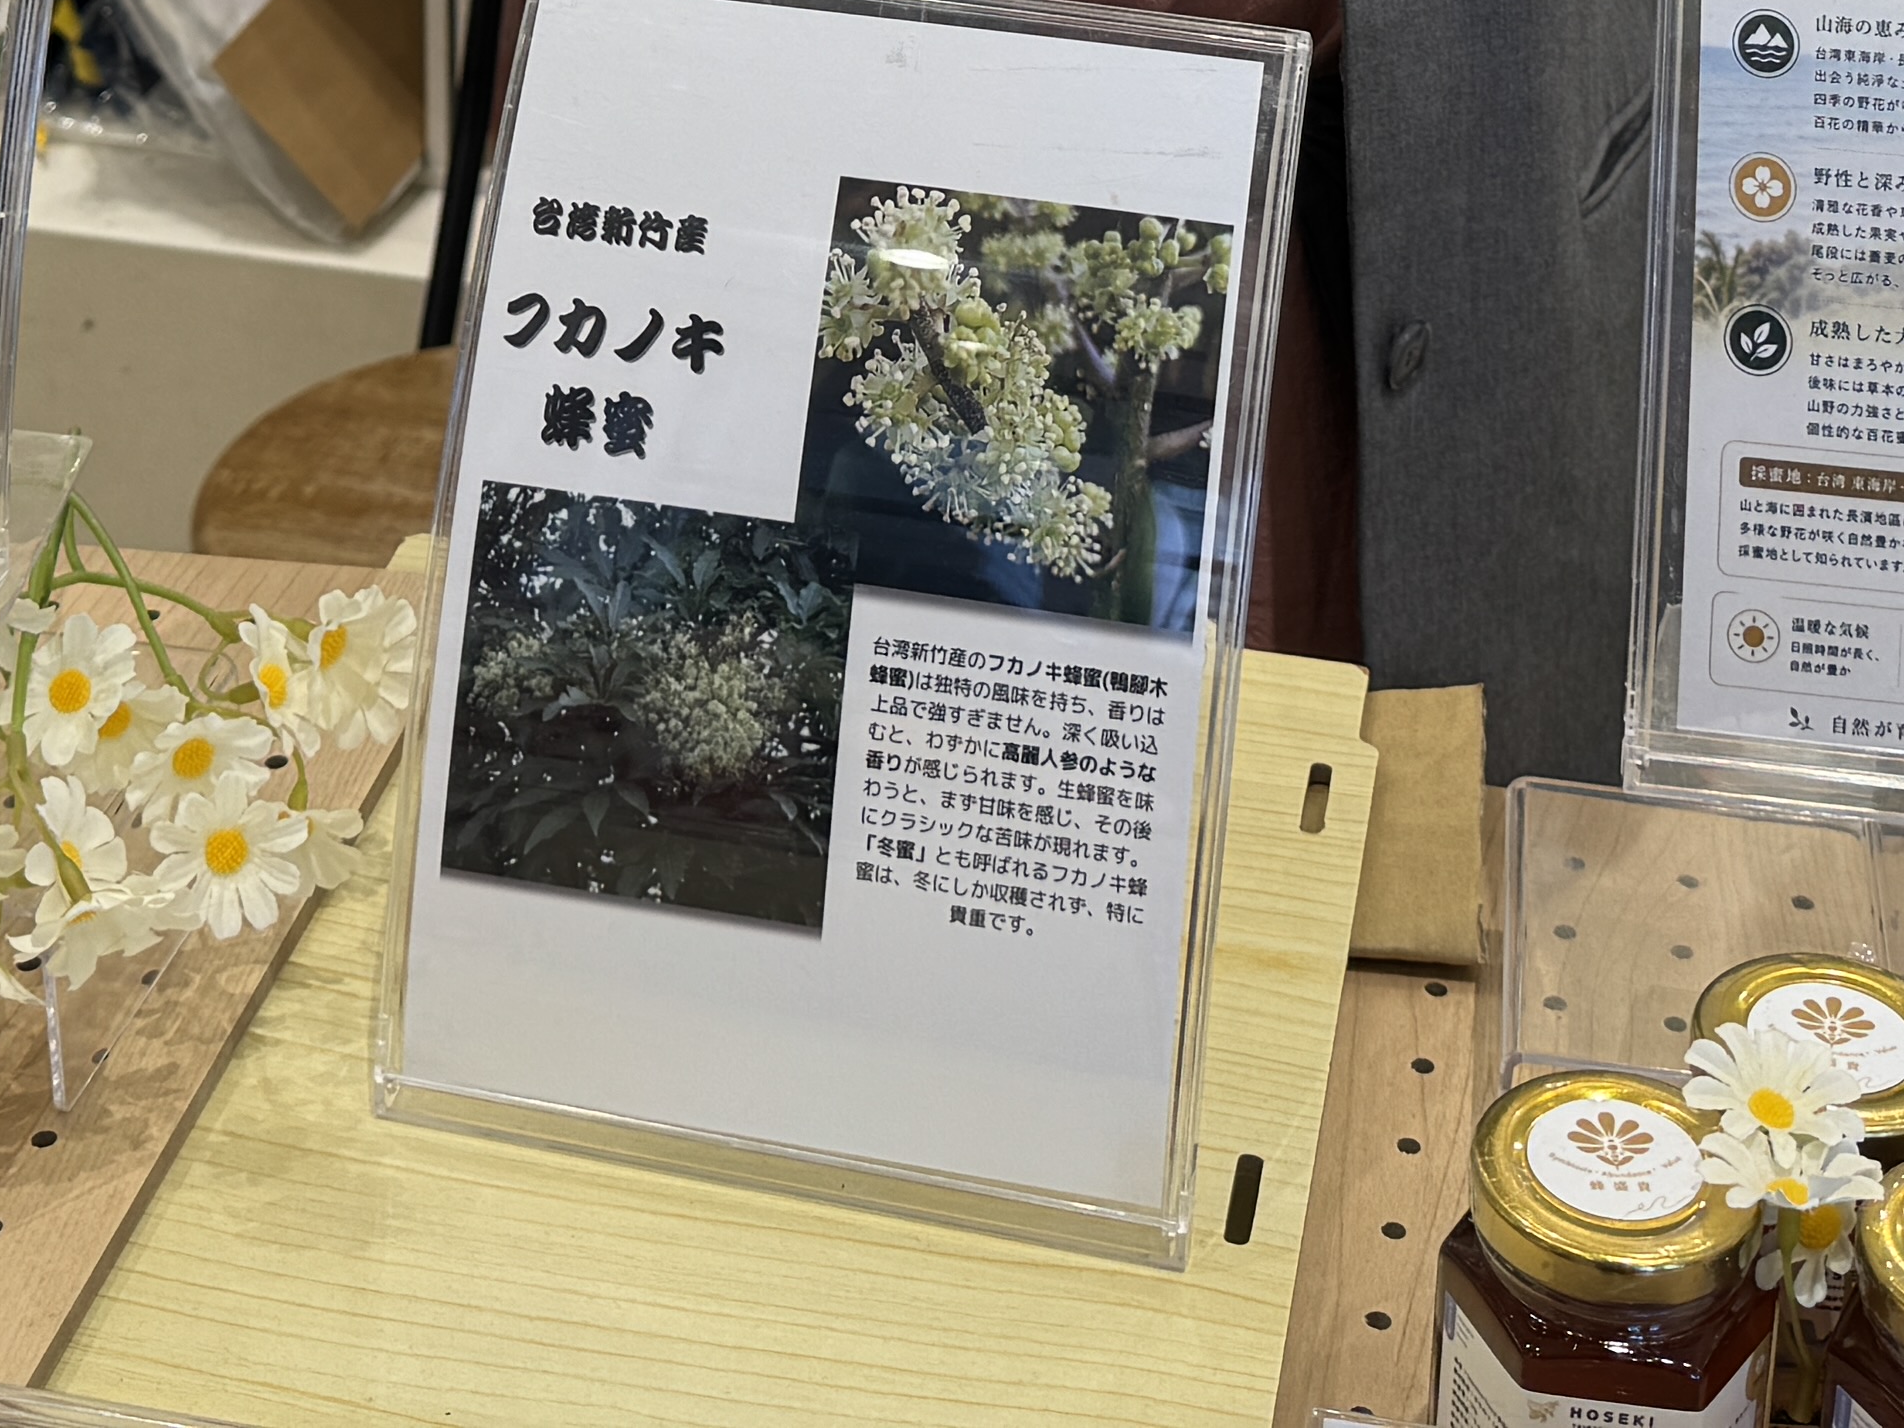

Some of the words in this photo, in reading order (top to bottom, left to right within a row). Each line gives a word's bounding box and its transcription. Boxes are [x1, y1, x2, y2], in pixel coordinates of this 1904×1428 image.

[503, 289, 726, 377] フカノキ
[541, 386, 655, 461] 蜂蜜
[868, 722, 1156, 783] むと、わずかに高麗人参のような
[871, 694, 1159, 756] 上品で強すぎません。深く吸い込
[863, 778, 1152, 841] わうと、まず甘味を感じ、その後
[865, 749, 1154, 811] 香りが感じられます。生蜂蜜を味
[860, 807, 1140, 868] にクラシックな苦味が現れます。
[865, 835, 1148, 897] 「冬蜜」とも呼ばれるフカノキ蜂
[855, 861, 1144, 924] 蜜は、冬にしか収穫されず、特に
[949, 905, 1035, 936] 貴重です。
[1570, 1406, 1655, 1428] HOSEKI
